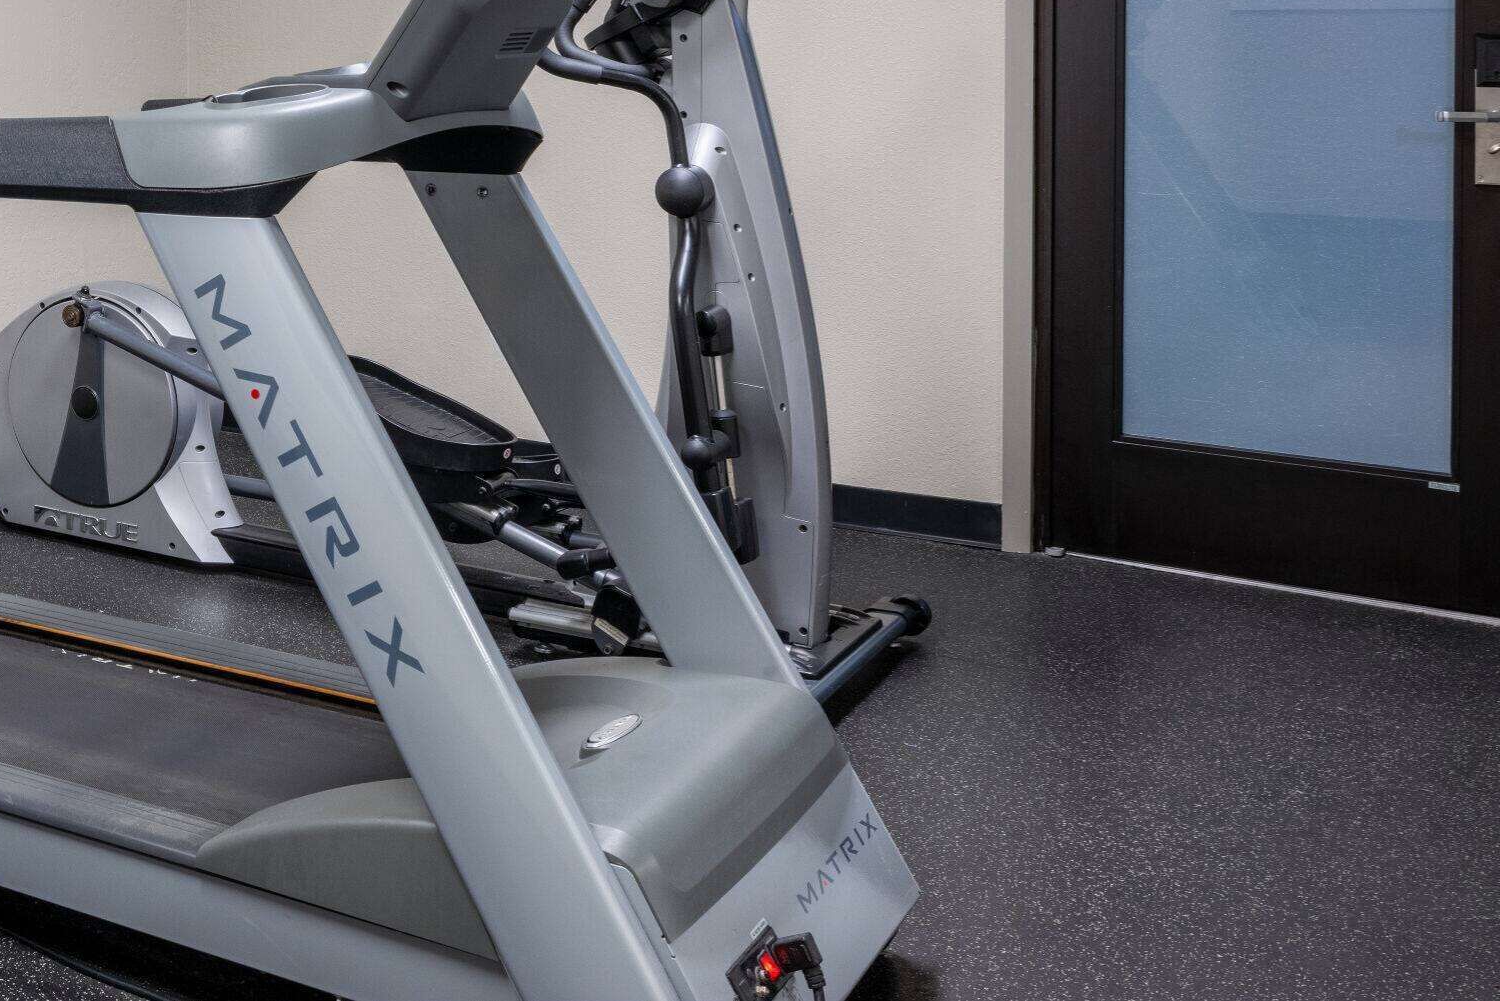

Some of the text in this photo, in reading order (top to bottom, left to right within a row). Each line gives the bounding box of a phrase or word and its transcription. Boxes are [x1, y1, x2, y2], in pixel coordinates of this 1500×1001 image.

[60, 510, 138, 543] TRUE
[194, 274, 425, 689] MATRIX
[797, 812, 879, 914] MATRIX
